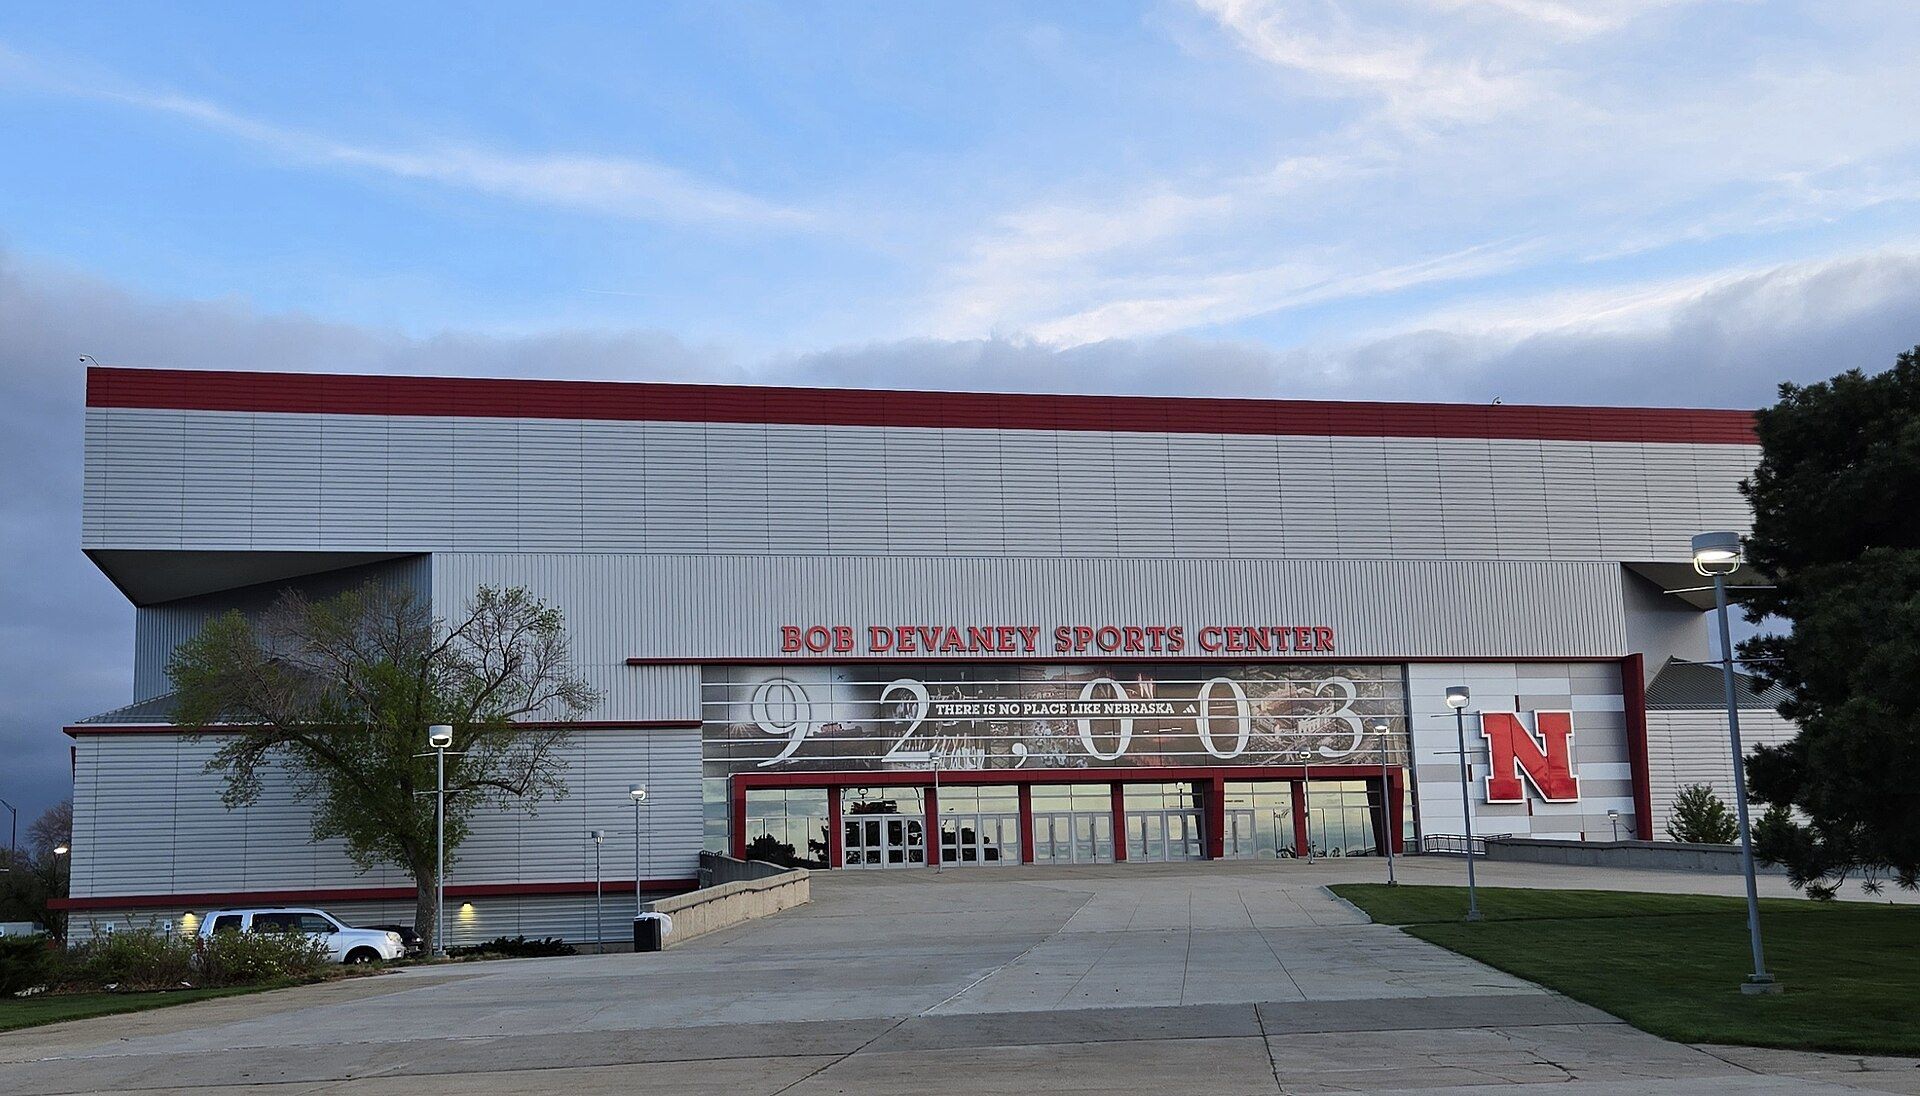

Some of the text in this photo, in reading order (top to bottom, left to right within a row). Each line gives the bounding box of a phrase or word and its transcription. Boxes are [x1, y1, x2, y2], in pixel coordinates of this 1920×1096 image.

[782, 625, 1335, 652] BOB DEVANEY SPORTS CENTER
[936, 703, 1175, 715] THERE IS NO PLACE LIKE NEBRASKA
[1480, 709, 1581, 804] N
